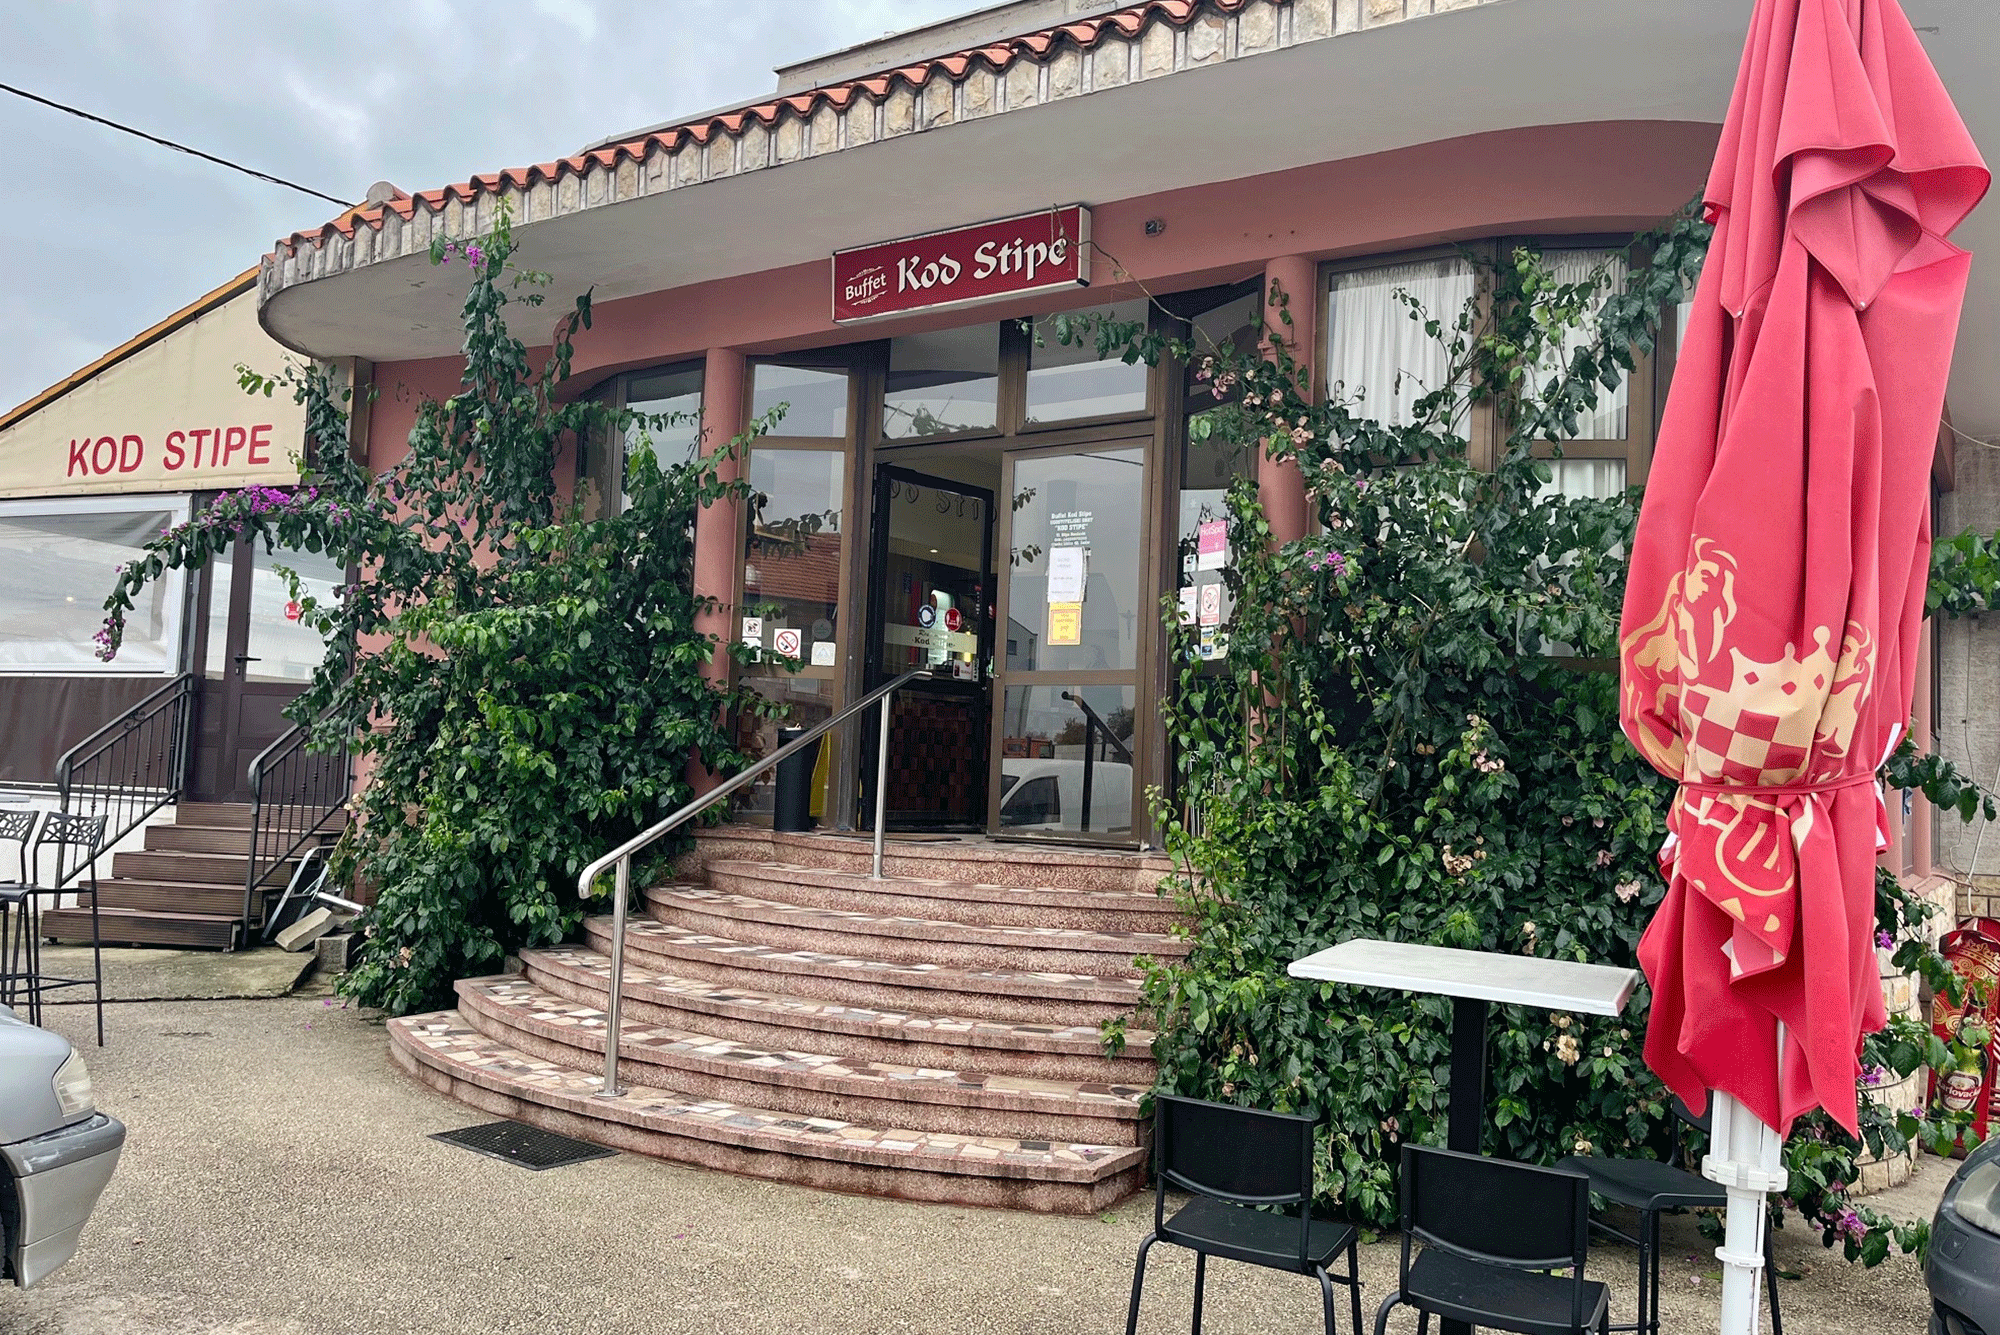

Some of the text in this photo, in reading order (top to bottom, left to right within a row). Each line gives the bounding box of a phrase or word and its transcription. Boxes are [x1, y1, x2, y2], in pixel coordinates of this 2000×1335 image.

[845, 237, 1068, 301] Buffet Kod Stipe
[67, 424, 273, 478] KOD STIPE
